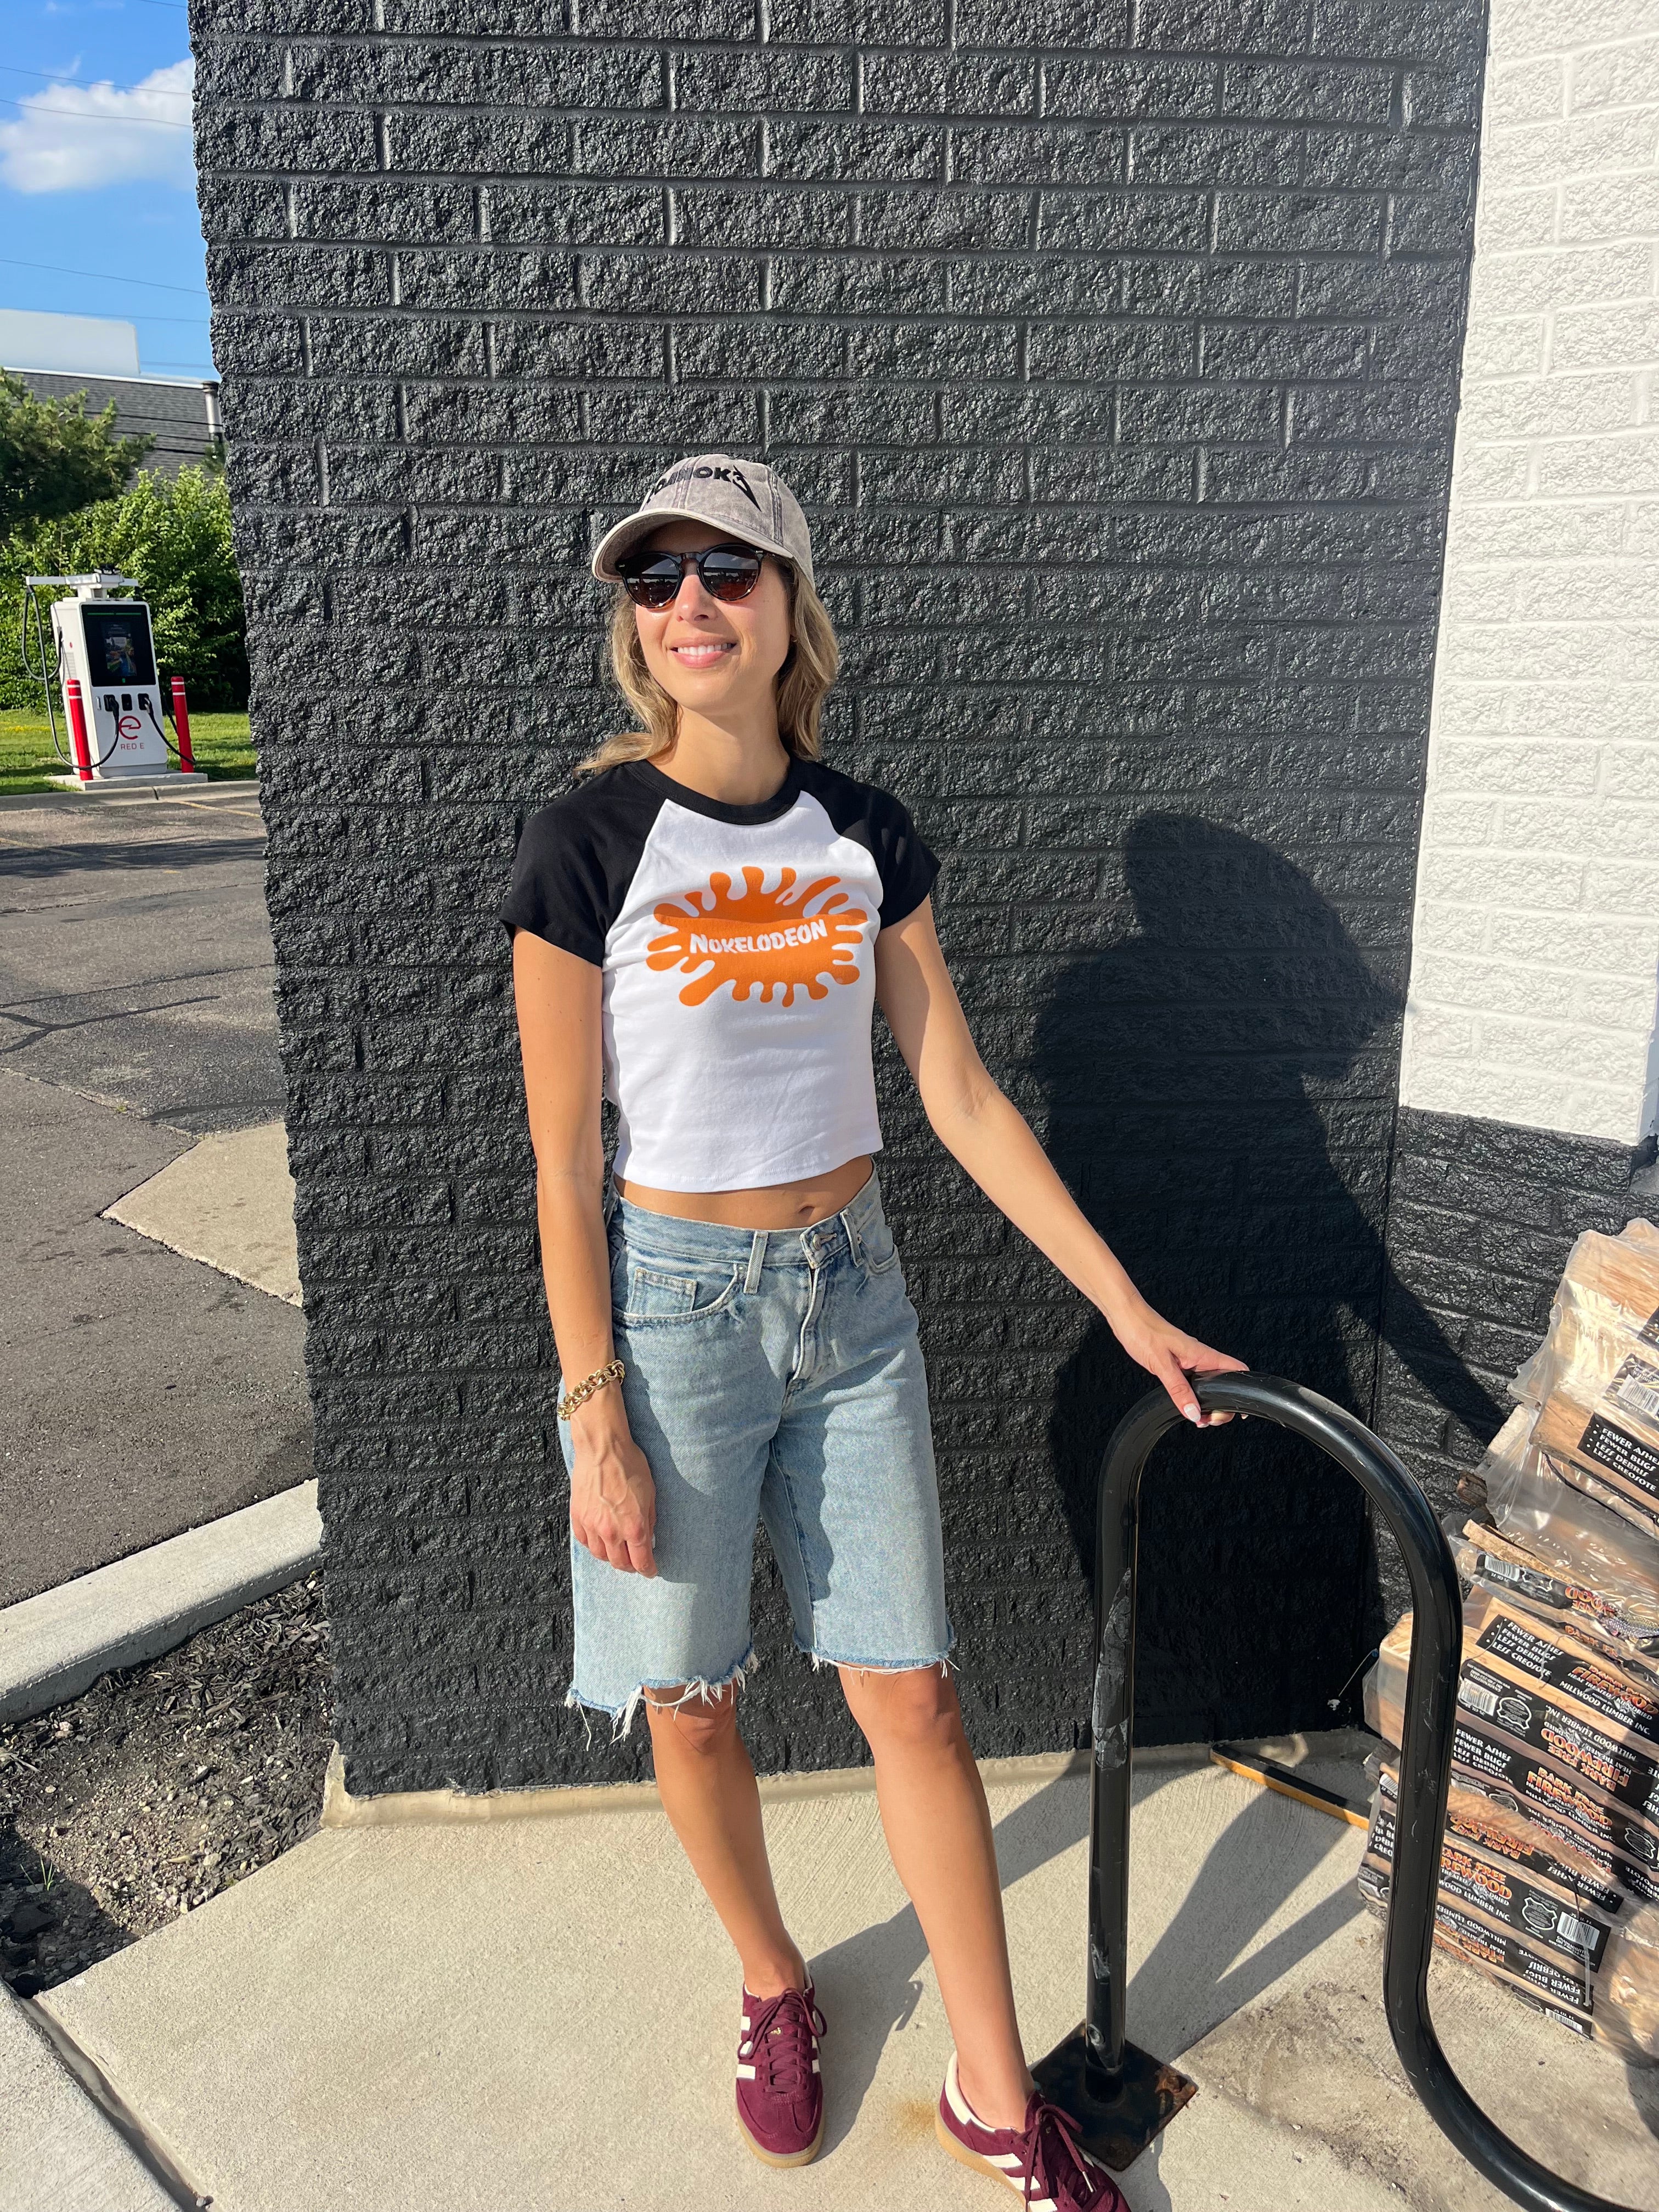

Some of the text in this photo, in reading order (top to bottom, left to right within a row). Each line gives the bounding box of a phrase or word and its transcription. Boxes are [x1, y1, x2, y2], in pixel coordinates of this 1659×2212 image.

[690, 919, 828, 954] NOKELODEON
[1602, 1428, 1632, 1449] FEWER
[1596, 1442, 1649, 1476] LESS DEBRIS
[1600, 1435, 1656, 1471] FEWER BUGS
[1593, 1448, 1656, 1492] LESS CREOSOTE
[1497, 1634, 1516, 1647] LESS
[1502, 1628, 1556, 1661] FEWER BUGS
[1508, 1622, 1564, 1656] FEWER ASHES
[1492, 1642, 1511, 1654] LESS
[1511, 1652, 1551, 1677] CREOSOTE
[1572, 1667, 1659, 1714] FIREWOOD
[1545, 1705, 1560, 1718] INC.
[1560, 1681, 1601, 1706] MILLWOOD
[1601, 1705, 1633, 1725] LUMBER
[1635, 1723, 1650, 1735] INC.
[1561, 1718, 1593, 1737] LUMBER
[1454, 1745, 1470, 1757] LESS
[1454, 1737, 1506, 1768] FEWER BUGS
[1454, 1752, 1469, 1763] LESS
[1456, 1729, 1511, 1762] FEWER ASHES
[1541, 1728, 1629, 1787] FIREWOOD
[1548, 1743, 1578, 1768] FREE
[1586, 1743, 1613, 1764] TREATED
[1594, 1735, 1637, 1762] MILLWOOD
[1580, 1763, 1616, 1792] BARK
[1615, 1762, 1632, 1774] HEAT
[1527, 1770, 1613, 1826] FIREWOOD
[1538, 1767, 1604, 1815] BARK FREE
[1483, 1838, 1520, 1860] BARK
[1441, 1868, 1468, 1883] TREATED
[1441, 1856, 1512, 1899] REWOOD
[1442, 1847, 1506, 1884] ARK FREE
[1577, 1881, 1606, 1901] FEWER
[1581, 1875, 1609, 1894] FEWER
[1464, 1892, 1494, 1912] LUMBER
[1496, 1909, 1511, 1922] INC.
[1467, 1921, 1506, 1945] MILLWOOD
[1525, 1970, 1580, 1994] FEWER BUGS
[1528, 1961, 1560, 1978] DEBRIS
[1550, 1988, 1579, 2004] FEWER
